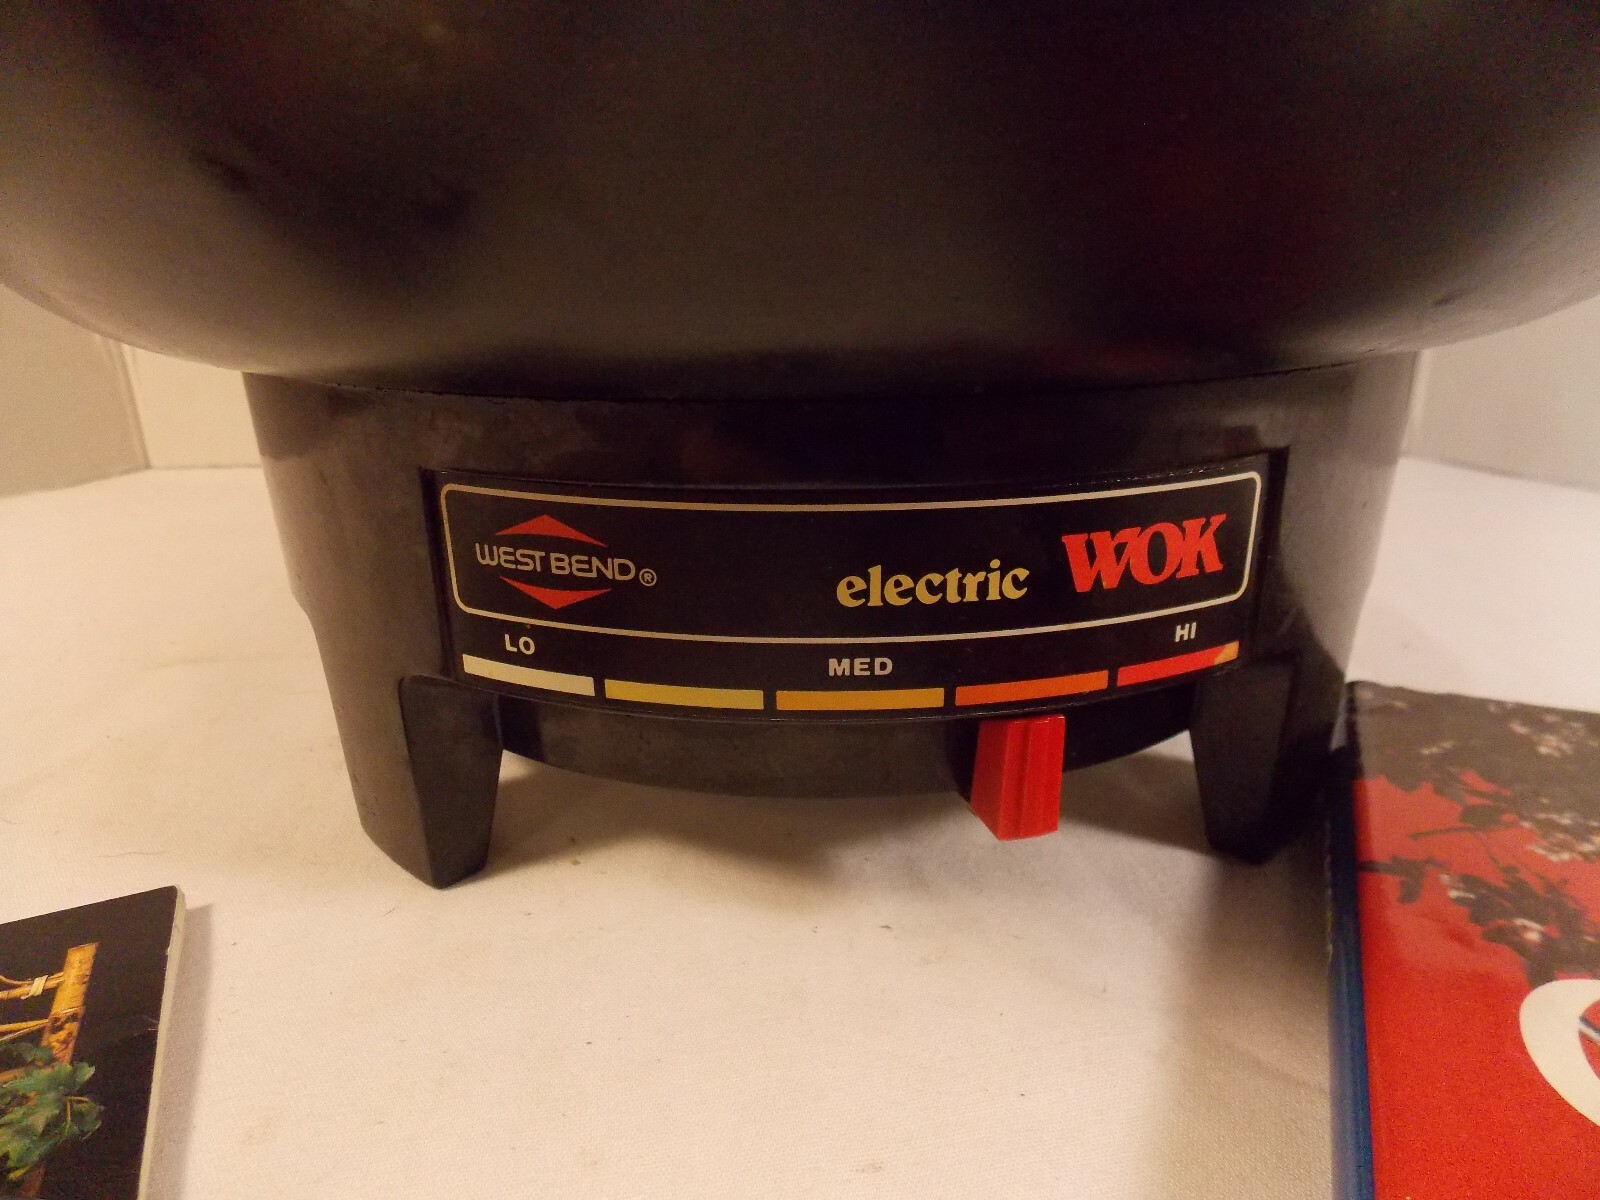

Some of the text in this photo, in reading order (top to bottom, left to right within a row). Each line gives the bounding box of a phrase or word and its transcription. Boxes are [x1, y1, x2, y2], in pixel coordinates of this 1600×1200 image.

[475, 542, 545, 573] WEST
[836, 512, 1228, 608] electric WOK
[1174, 621, 1197, 643] HI
[504, 633, 536, 655] LO
[828, 657, 893, 677] MED
